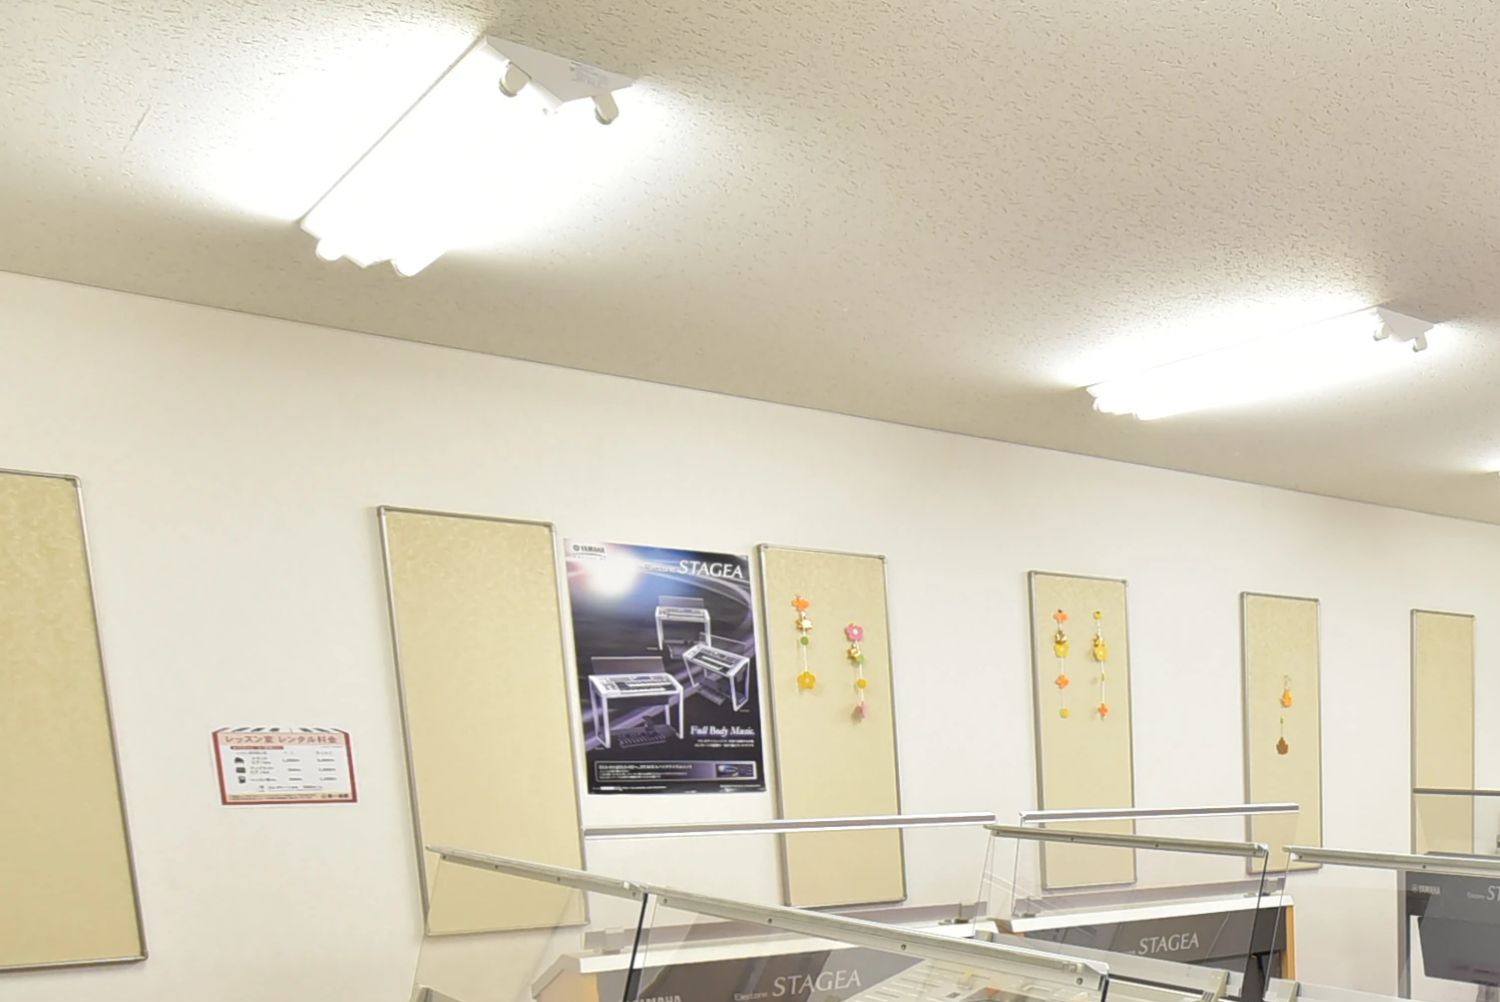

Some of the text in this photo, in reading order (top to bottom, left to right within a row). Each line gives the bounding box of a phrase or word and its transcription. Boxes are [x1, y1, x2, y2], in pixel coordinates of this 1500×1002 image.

[679, 559, 743, 579] STAGEA
[1138, 933, 1199, 955] STAGEA
[772, 969, 862, 998] STAGEA
